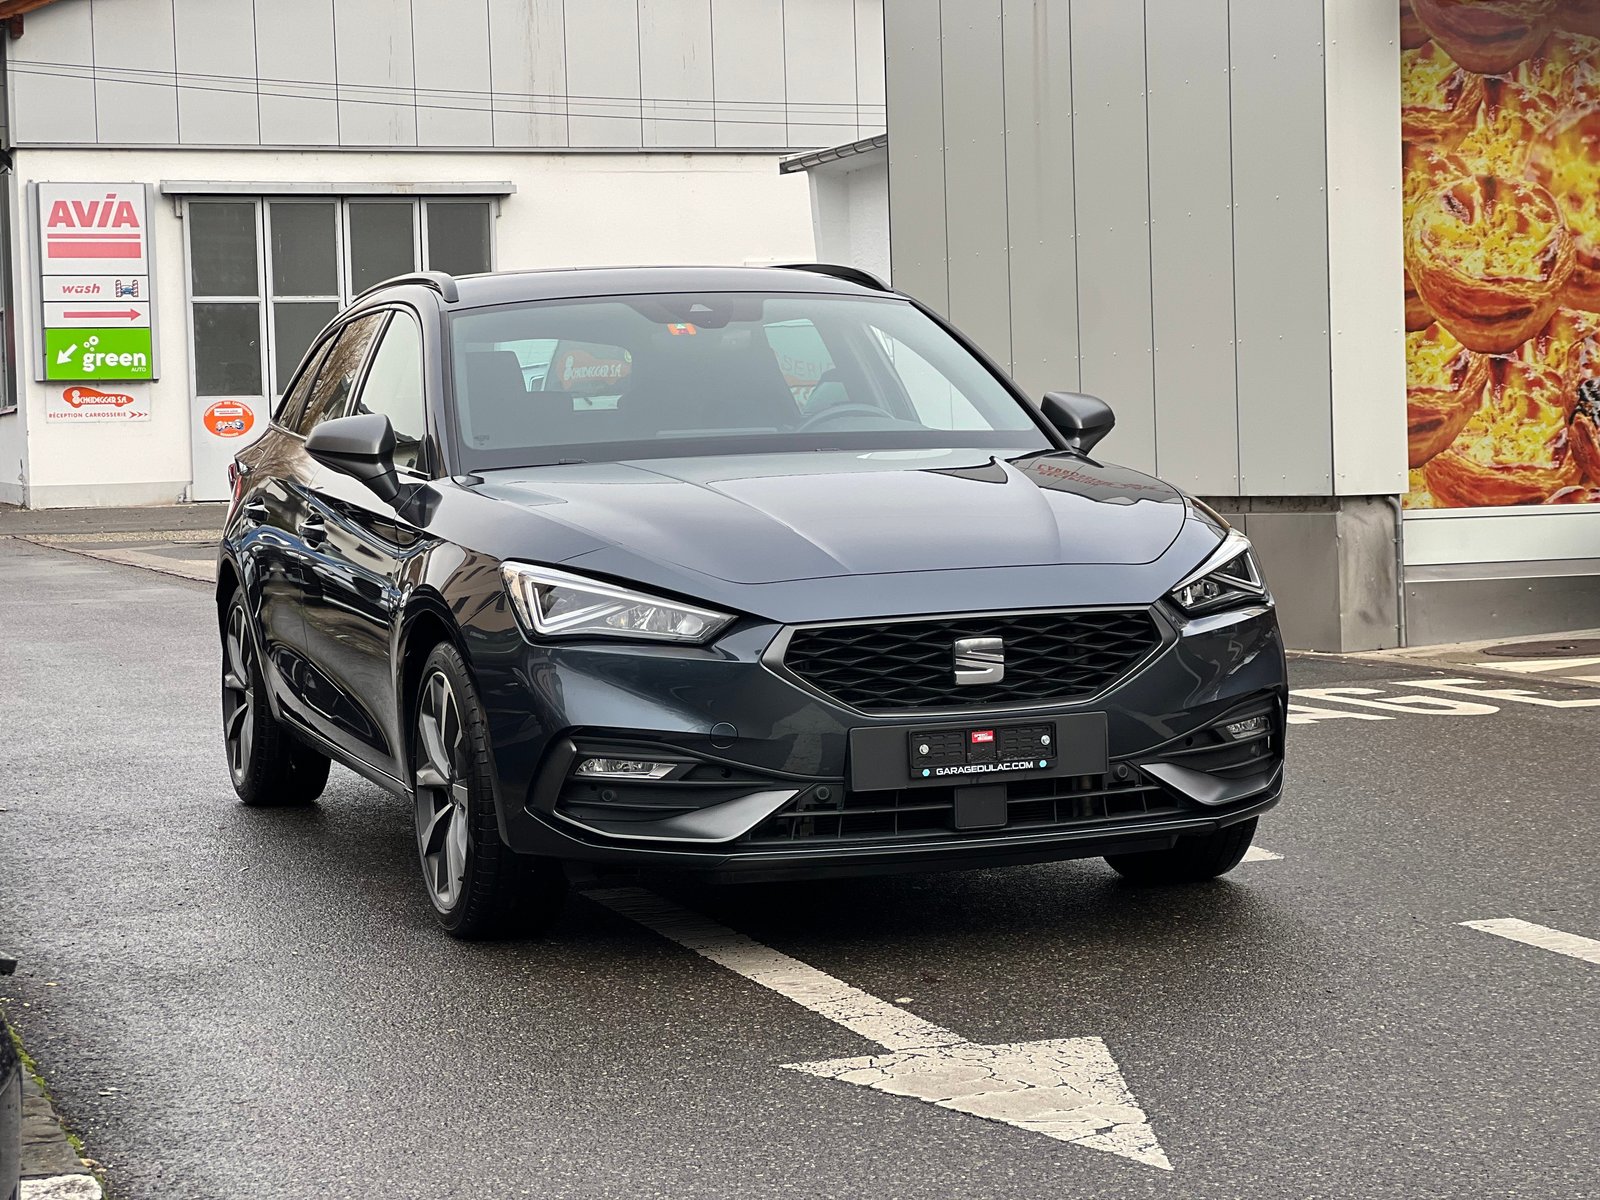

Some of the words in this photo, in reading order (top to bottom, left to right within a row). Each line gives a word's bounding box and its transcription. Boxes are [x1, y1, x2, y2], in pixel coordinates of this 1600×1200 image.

[47, 193, 140, 228] AVIA
[62, 284, 101, 294] wash
[82, 352, 147, 372] green
[936, 761, 1034, 775] GARAGEDULAC.COM
